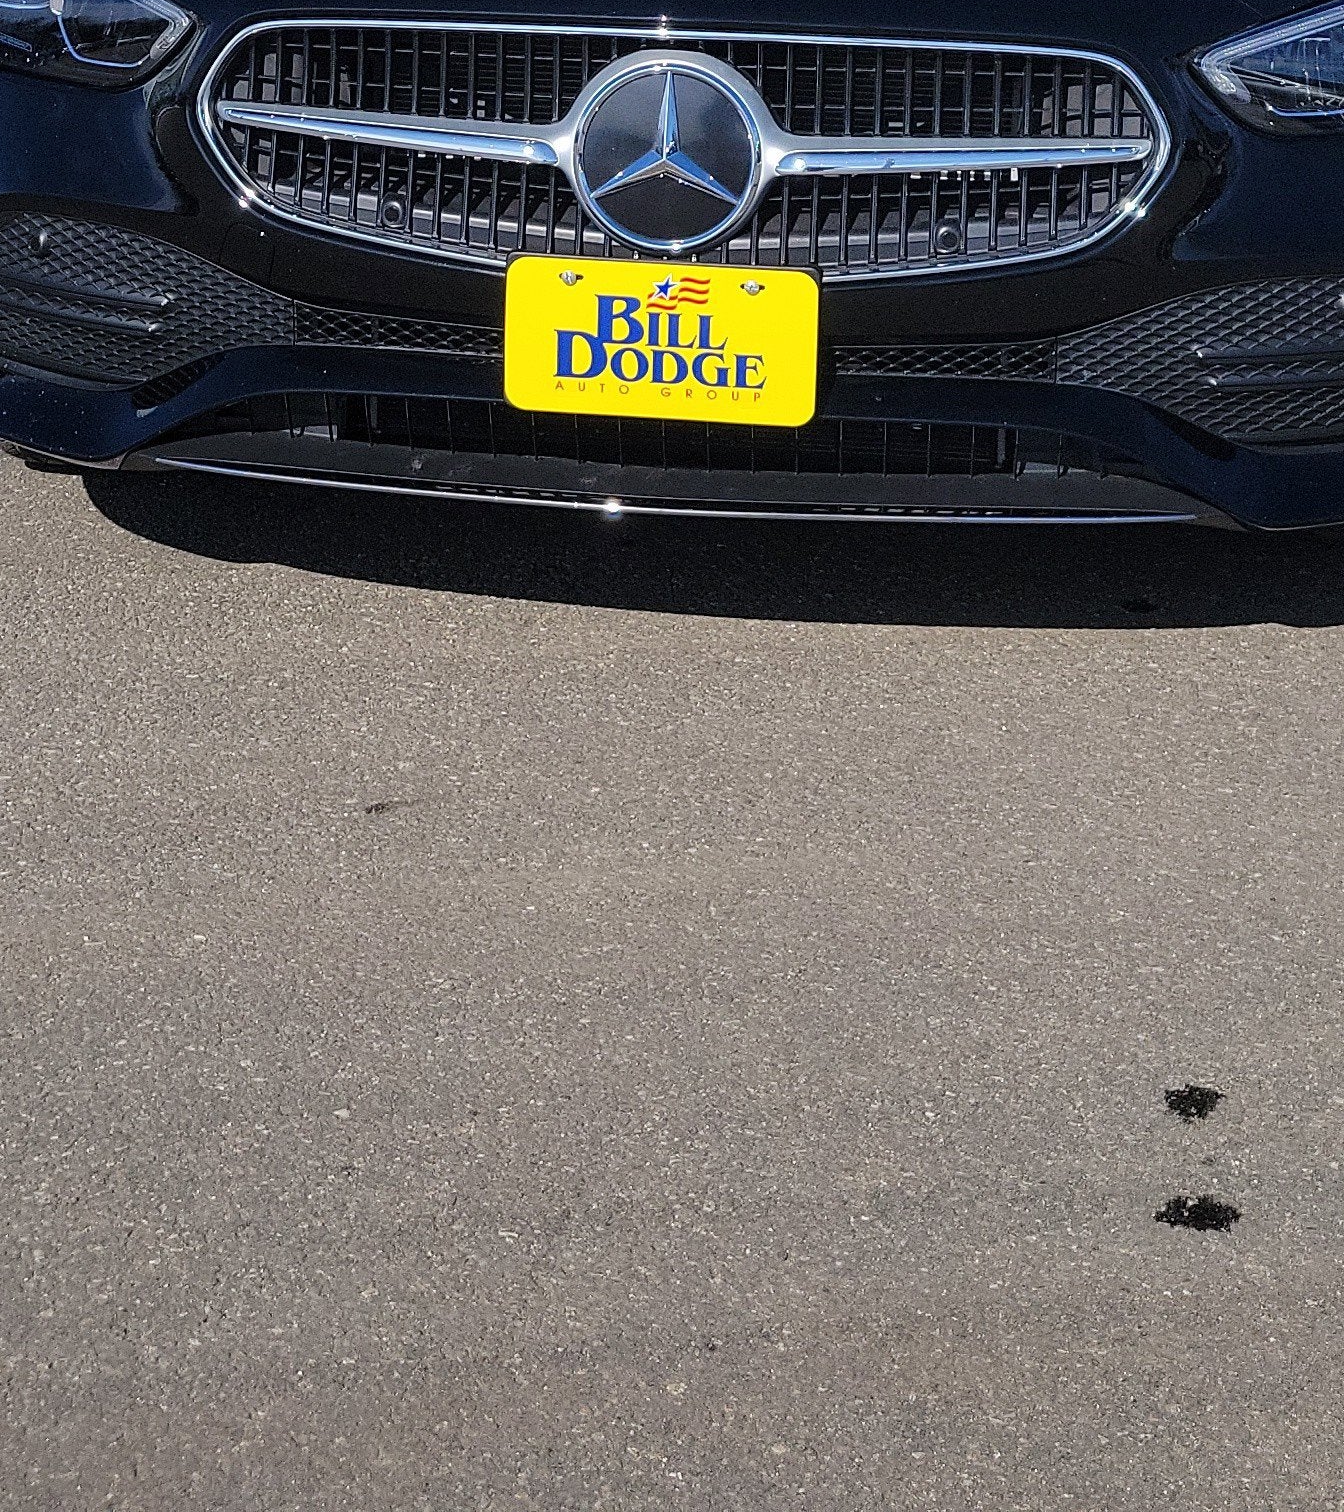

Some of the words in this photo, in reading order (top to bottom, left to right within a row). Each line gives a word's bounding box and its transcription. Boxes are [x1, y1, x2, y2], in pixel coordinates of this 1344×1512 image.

[594, 294, 728, 350] BILL
[553, 329, 767, 389] DODGE
[555, 380, 630, 395] AUTO
[660, 387, 761, 402] GROUP
